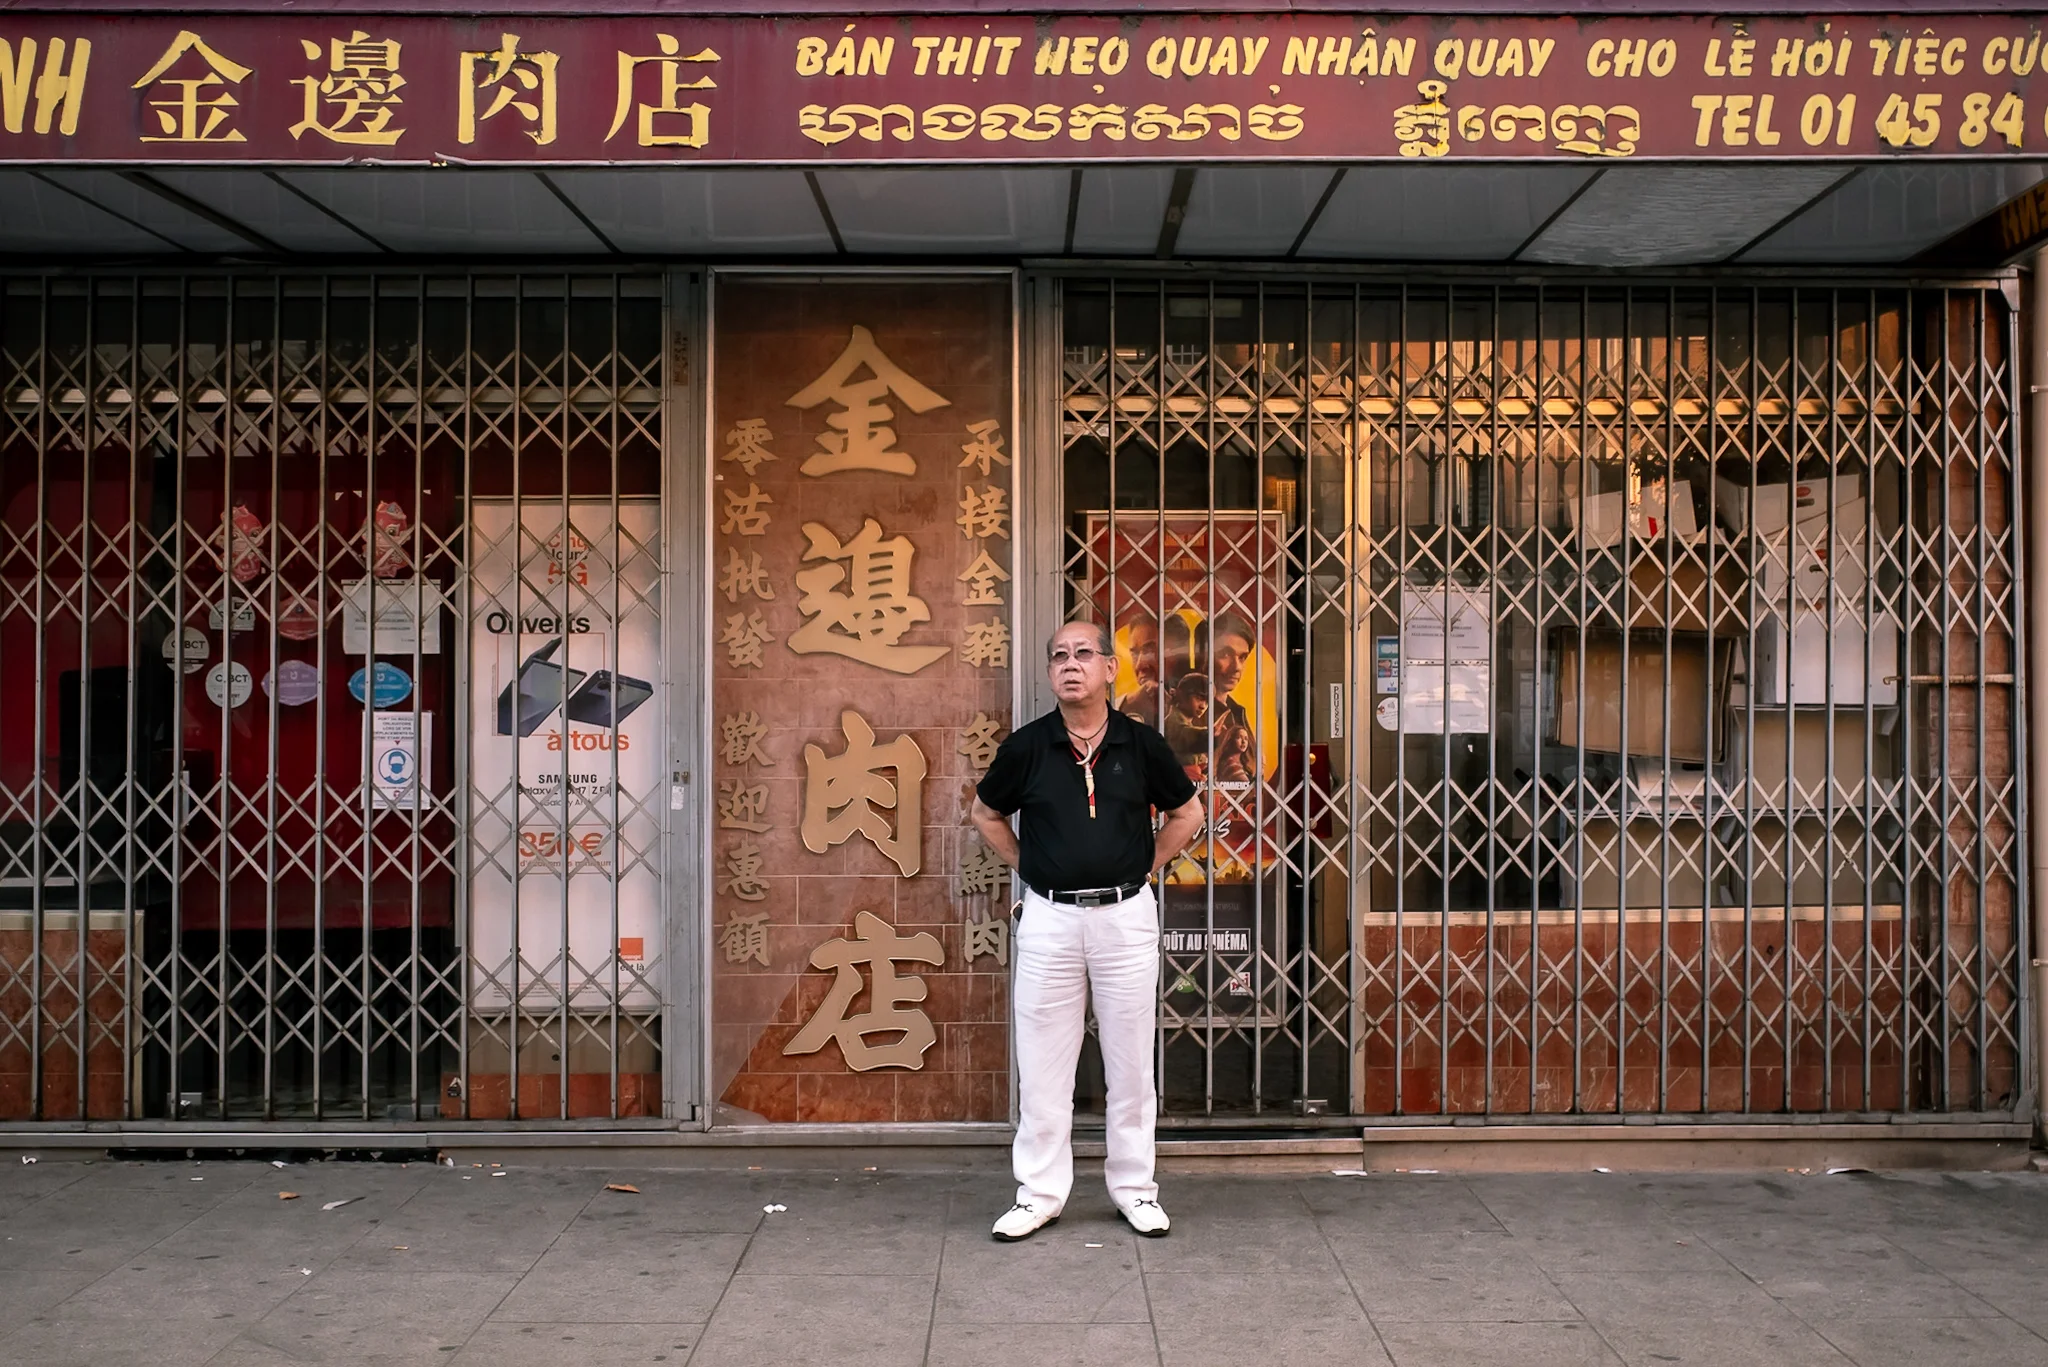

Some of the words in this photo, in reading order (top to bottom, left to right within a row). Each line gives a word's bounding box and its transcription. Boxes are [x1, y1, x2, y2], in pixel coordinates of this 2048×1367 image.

[795, 24, 895, 77] BÁN
[1146, 36, 1267, 80] QUAY
[1281, 28, 1418, 86] NHẬN
[1434, 37, 1556, 81] QUAY
[1587, 38, 1677, 78] CHO
[1691, 94, 1781, 147] TEL
[1800, 93, 1857, 146] 01
[1875, 93, 1942, 147] 45
[1958, 91, 2024, 148] 84
[547, 729, 562, 751] à
[571, 730, 630, 751] tous
[520, 832, 575, 857] 350
[1186, 934, 1202, 950] AU
